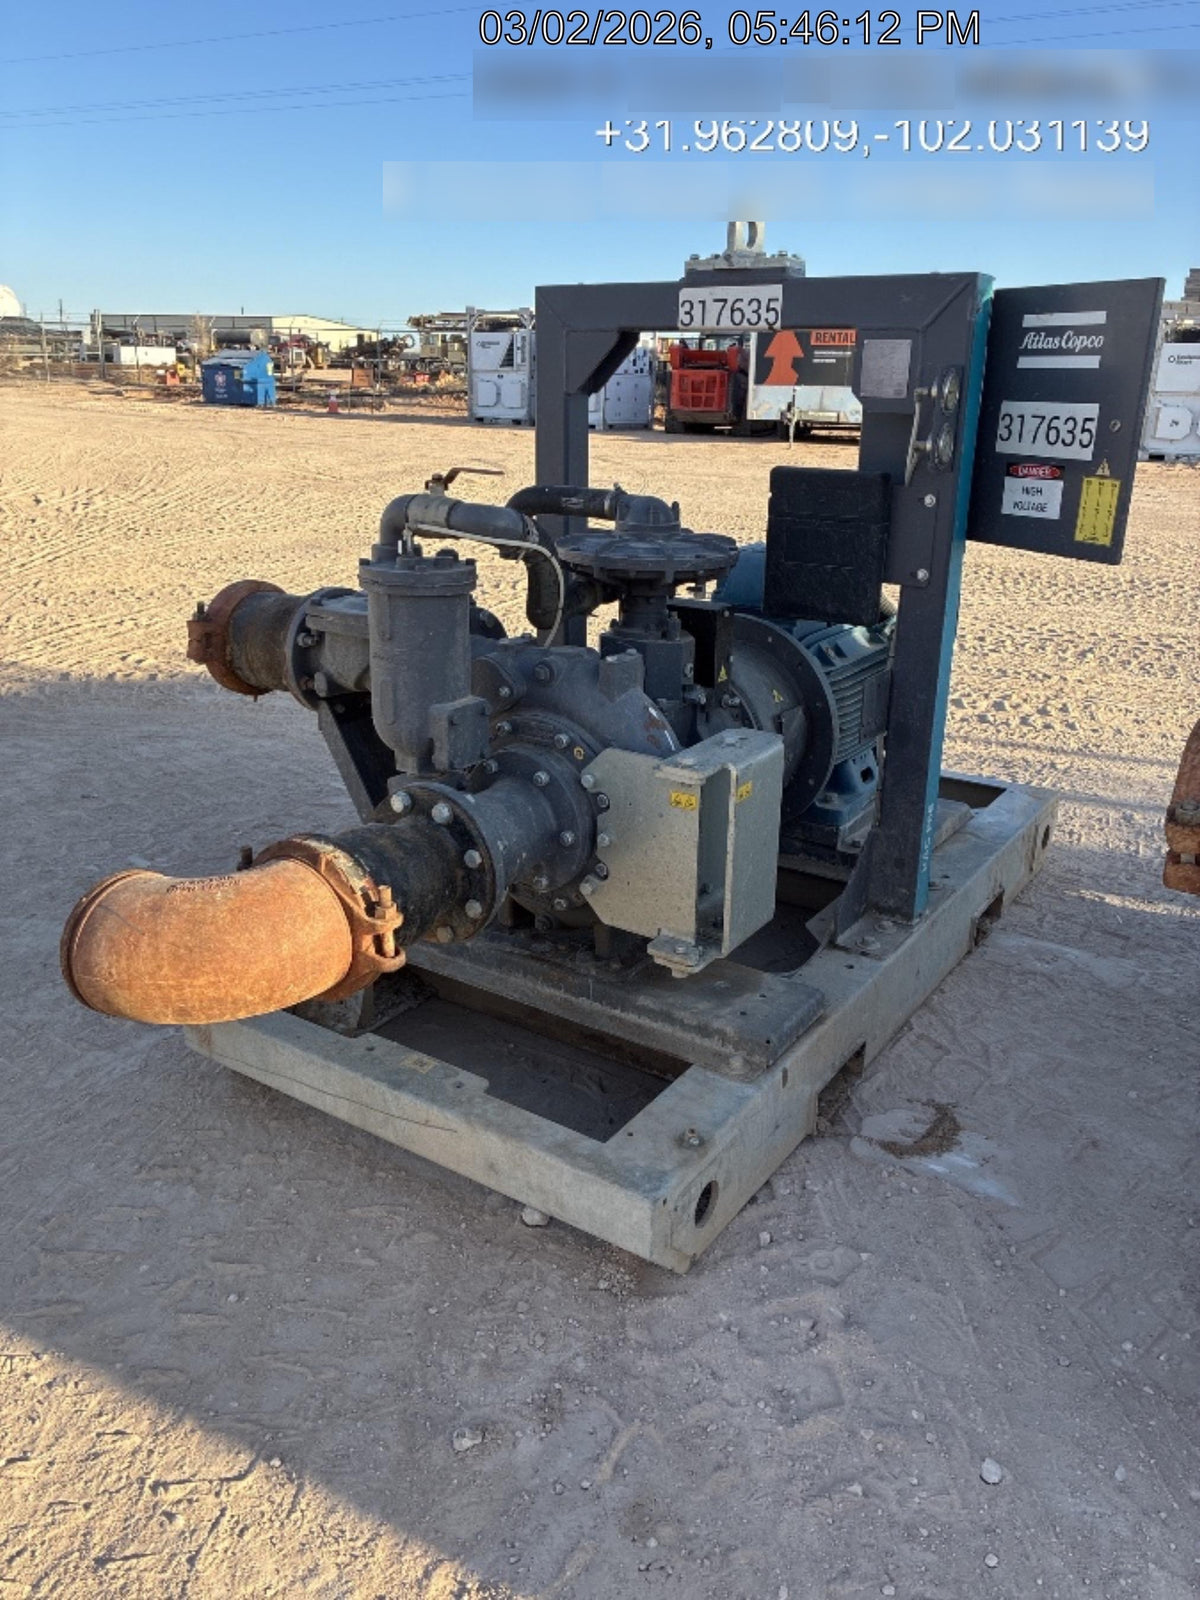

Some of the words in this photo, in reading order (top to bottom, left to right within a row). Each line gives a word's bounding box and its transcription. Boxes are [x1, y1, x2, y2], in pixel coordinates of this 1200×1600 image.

[679, 297, 780, 328] 317635
[815, 331, 856, 344] RENTAL
[1019, 331, 1060, 349] Atlas
[1061, 330, 1104, 353] Copco
[999, 413, 1096, 449] 317635
[1021, 486, 1043, 497] HIGH
